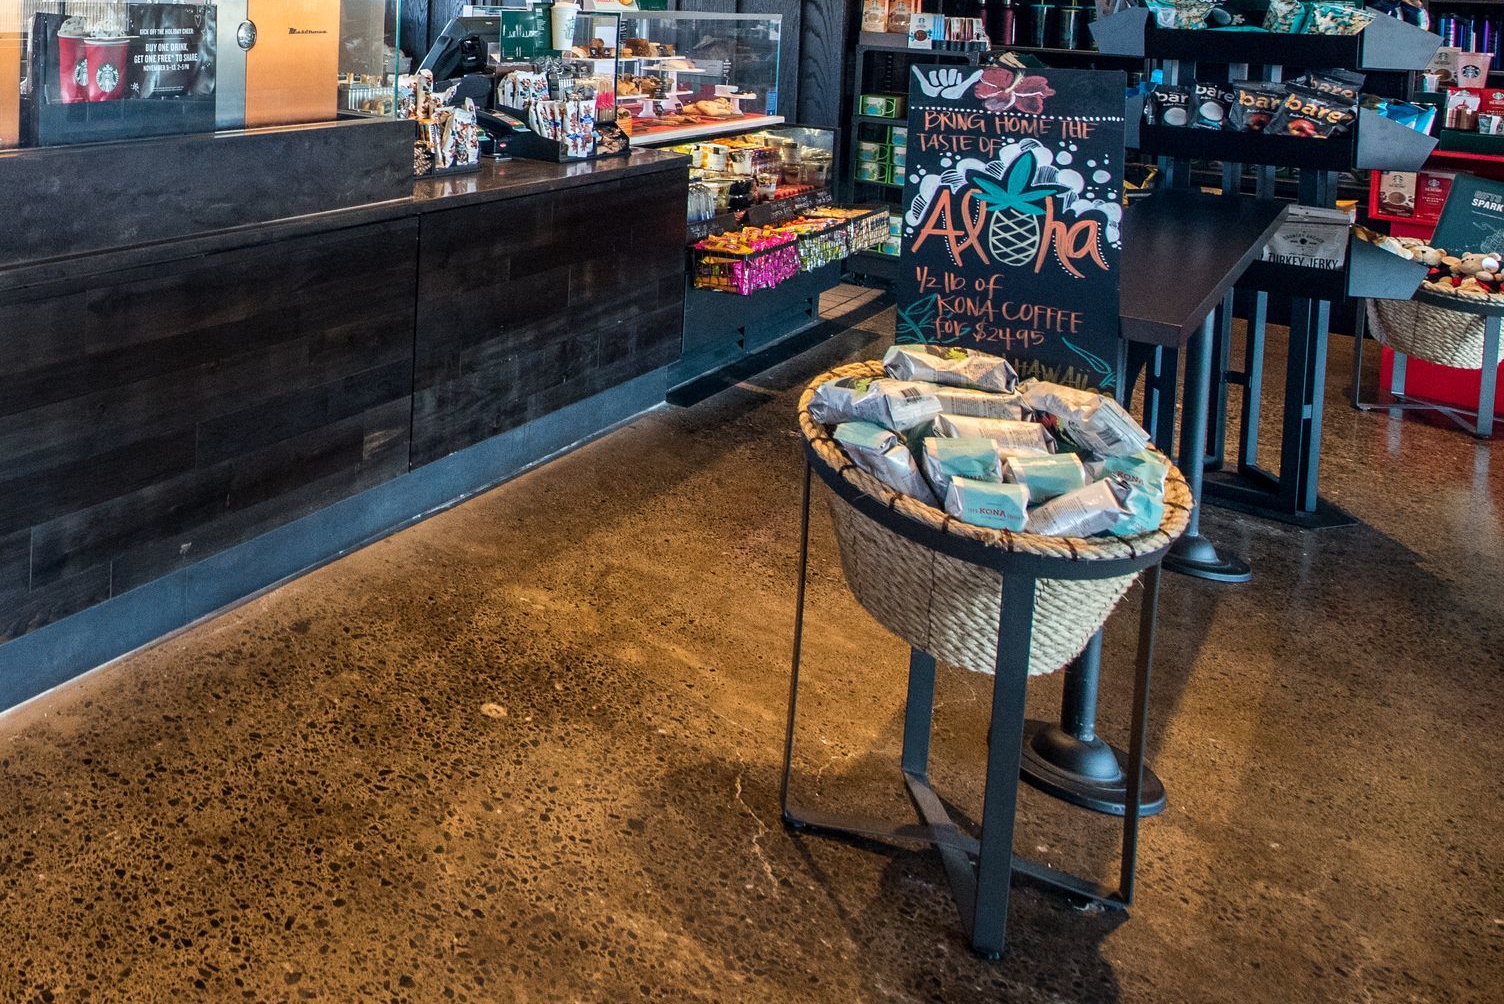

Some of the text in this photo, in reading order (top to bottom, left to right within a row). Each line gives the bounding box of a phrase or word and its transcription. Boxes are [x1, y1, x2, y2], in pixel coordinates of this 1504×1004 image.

[158, 43, 169, 51] ONE
[171, 43, 188, 51] DRINK,
[134, 55, 143, 63] GET
[145, 55, 156, 63] ONE
[176, 54, 182, 62] TO
[183, 53, 198, 62] SHARE
[1155, 91, 1188, 103] bar
[1196, 83, 1234, 103] bare
[1239, 90, 1282, 108] bar
[1285, 93, 1346, 123] bare
[924, 111, 1099, 141] BRING HOME THE
[917, 132, 1004, 159] TASTE OF
[1471, 198, 1504, 212] SPARK
[1474, 190, 1502, 203] GIFTS
[1268, 253, 1338, 270] TURKEY JERKY
[975, 275, 1005, 298] of
[937, 293, 1086, 334] KONA COFFEE
[935, 315, 964, 337] for
[1117, 471, 1144, 485] KONA
[979, 508, 1006, 518] KONA
